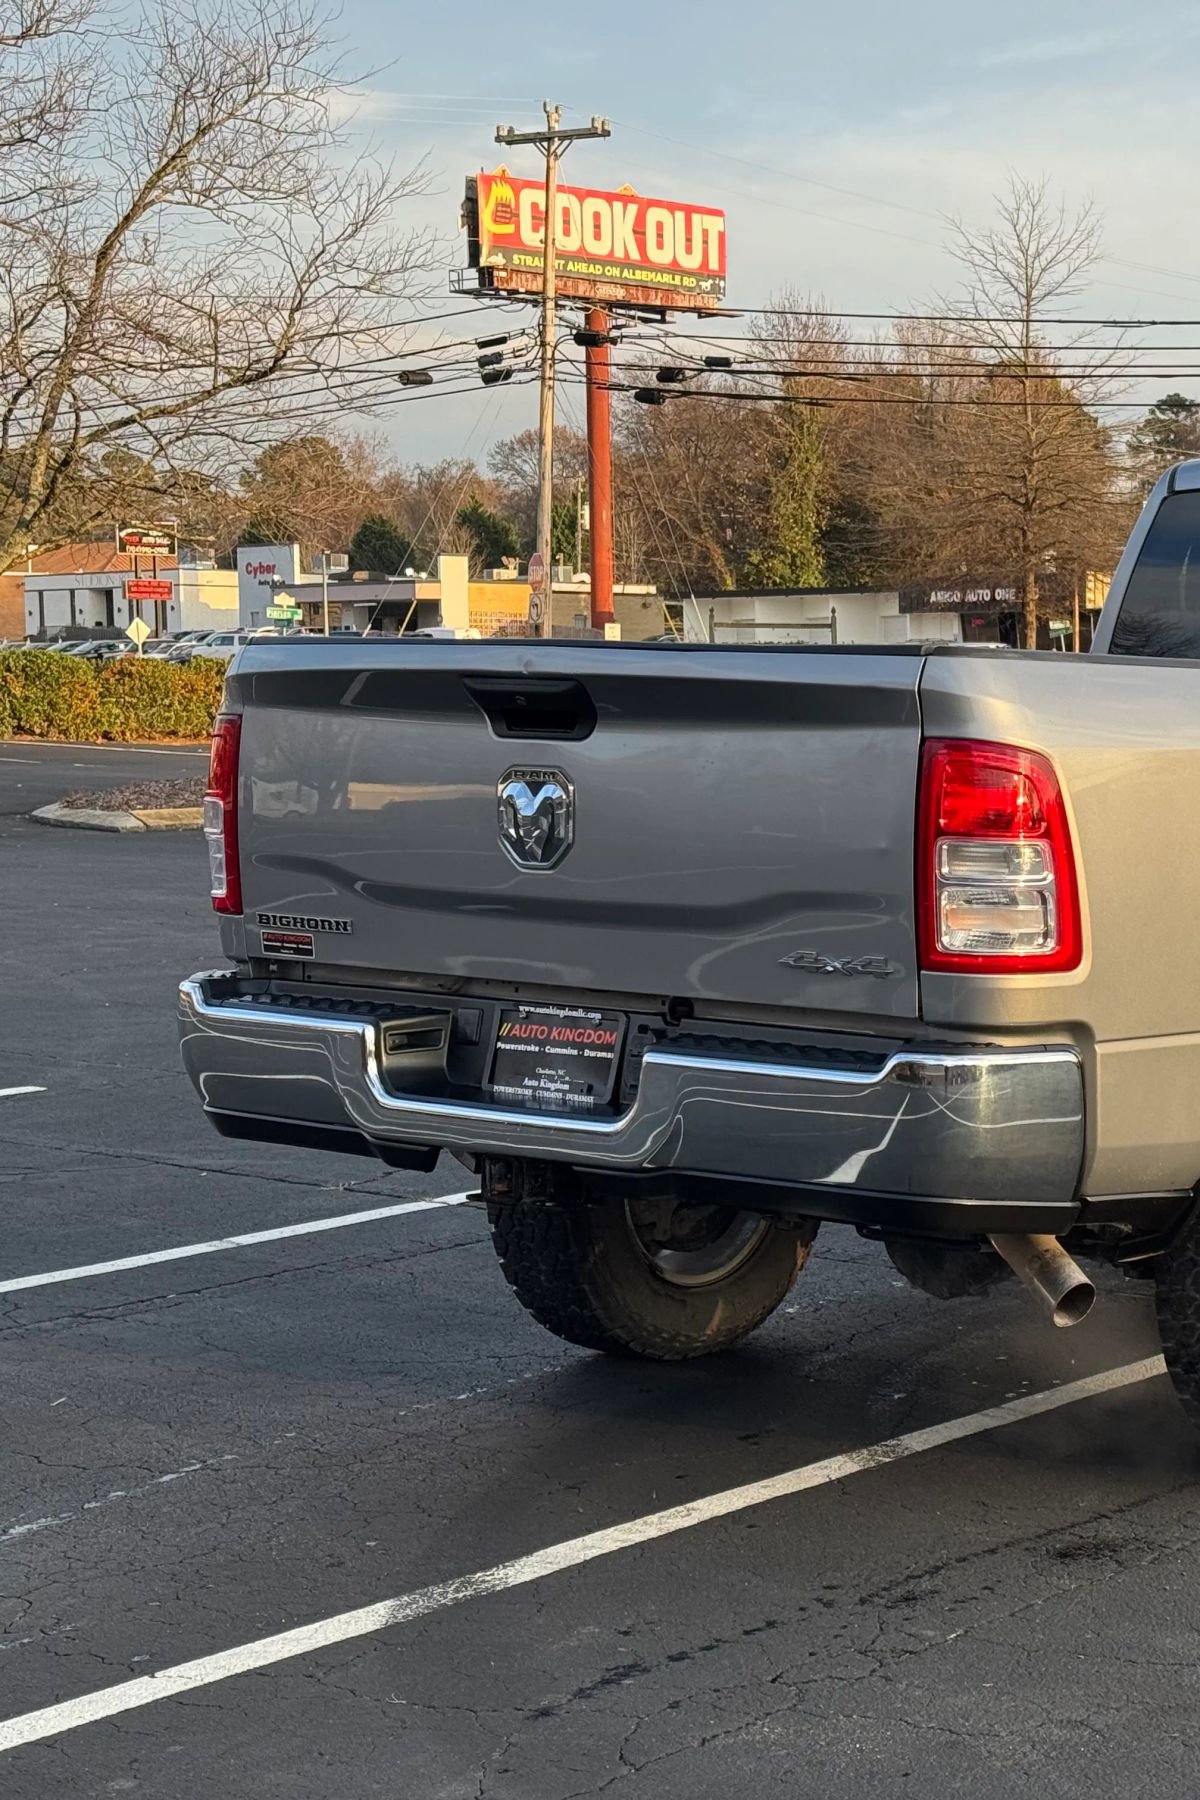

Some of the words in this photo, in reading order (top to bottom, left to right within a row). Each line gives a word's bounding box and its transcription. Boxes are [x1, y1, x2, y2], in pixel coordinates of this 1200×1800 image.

[519, 188, 641, 261] COOK
[645, 207, 725, 271] OUT
[566, 260, 604, 275] AHEAD
[604, 266, 620, 278] ON
[622, 269, 682, 287] ALBEMARLE
[683, 276, 697, 288] RD
[245, 562, 276, 579] Cyber
[965, 588, 991, 601] AUTO
[994, 588, 1016, 601] ONE
[511, 770, 561, 781] RAM
[510, 1023, 548, 1039] AUTO
[550, 1028, 618, 1045] KINGDOM
[496, 1041, 540, 1053] Powerstroke
[545, 1045, 579, 1056] Cummins
[539, 1079, 570, 1091] Kingdom
